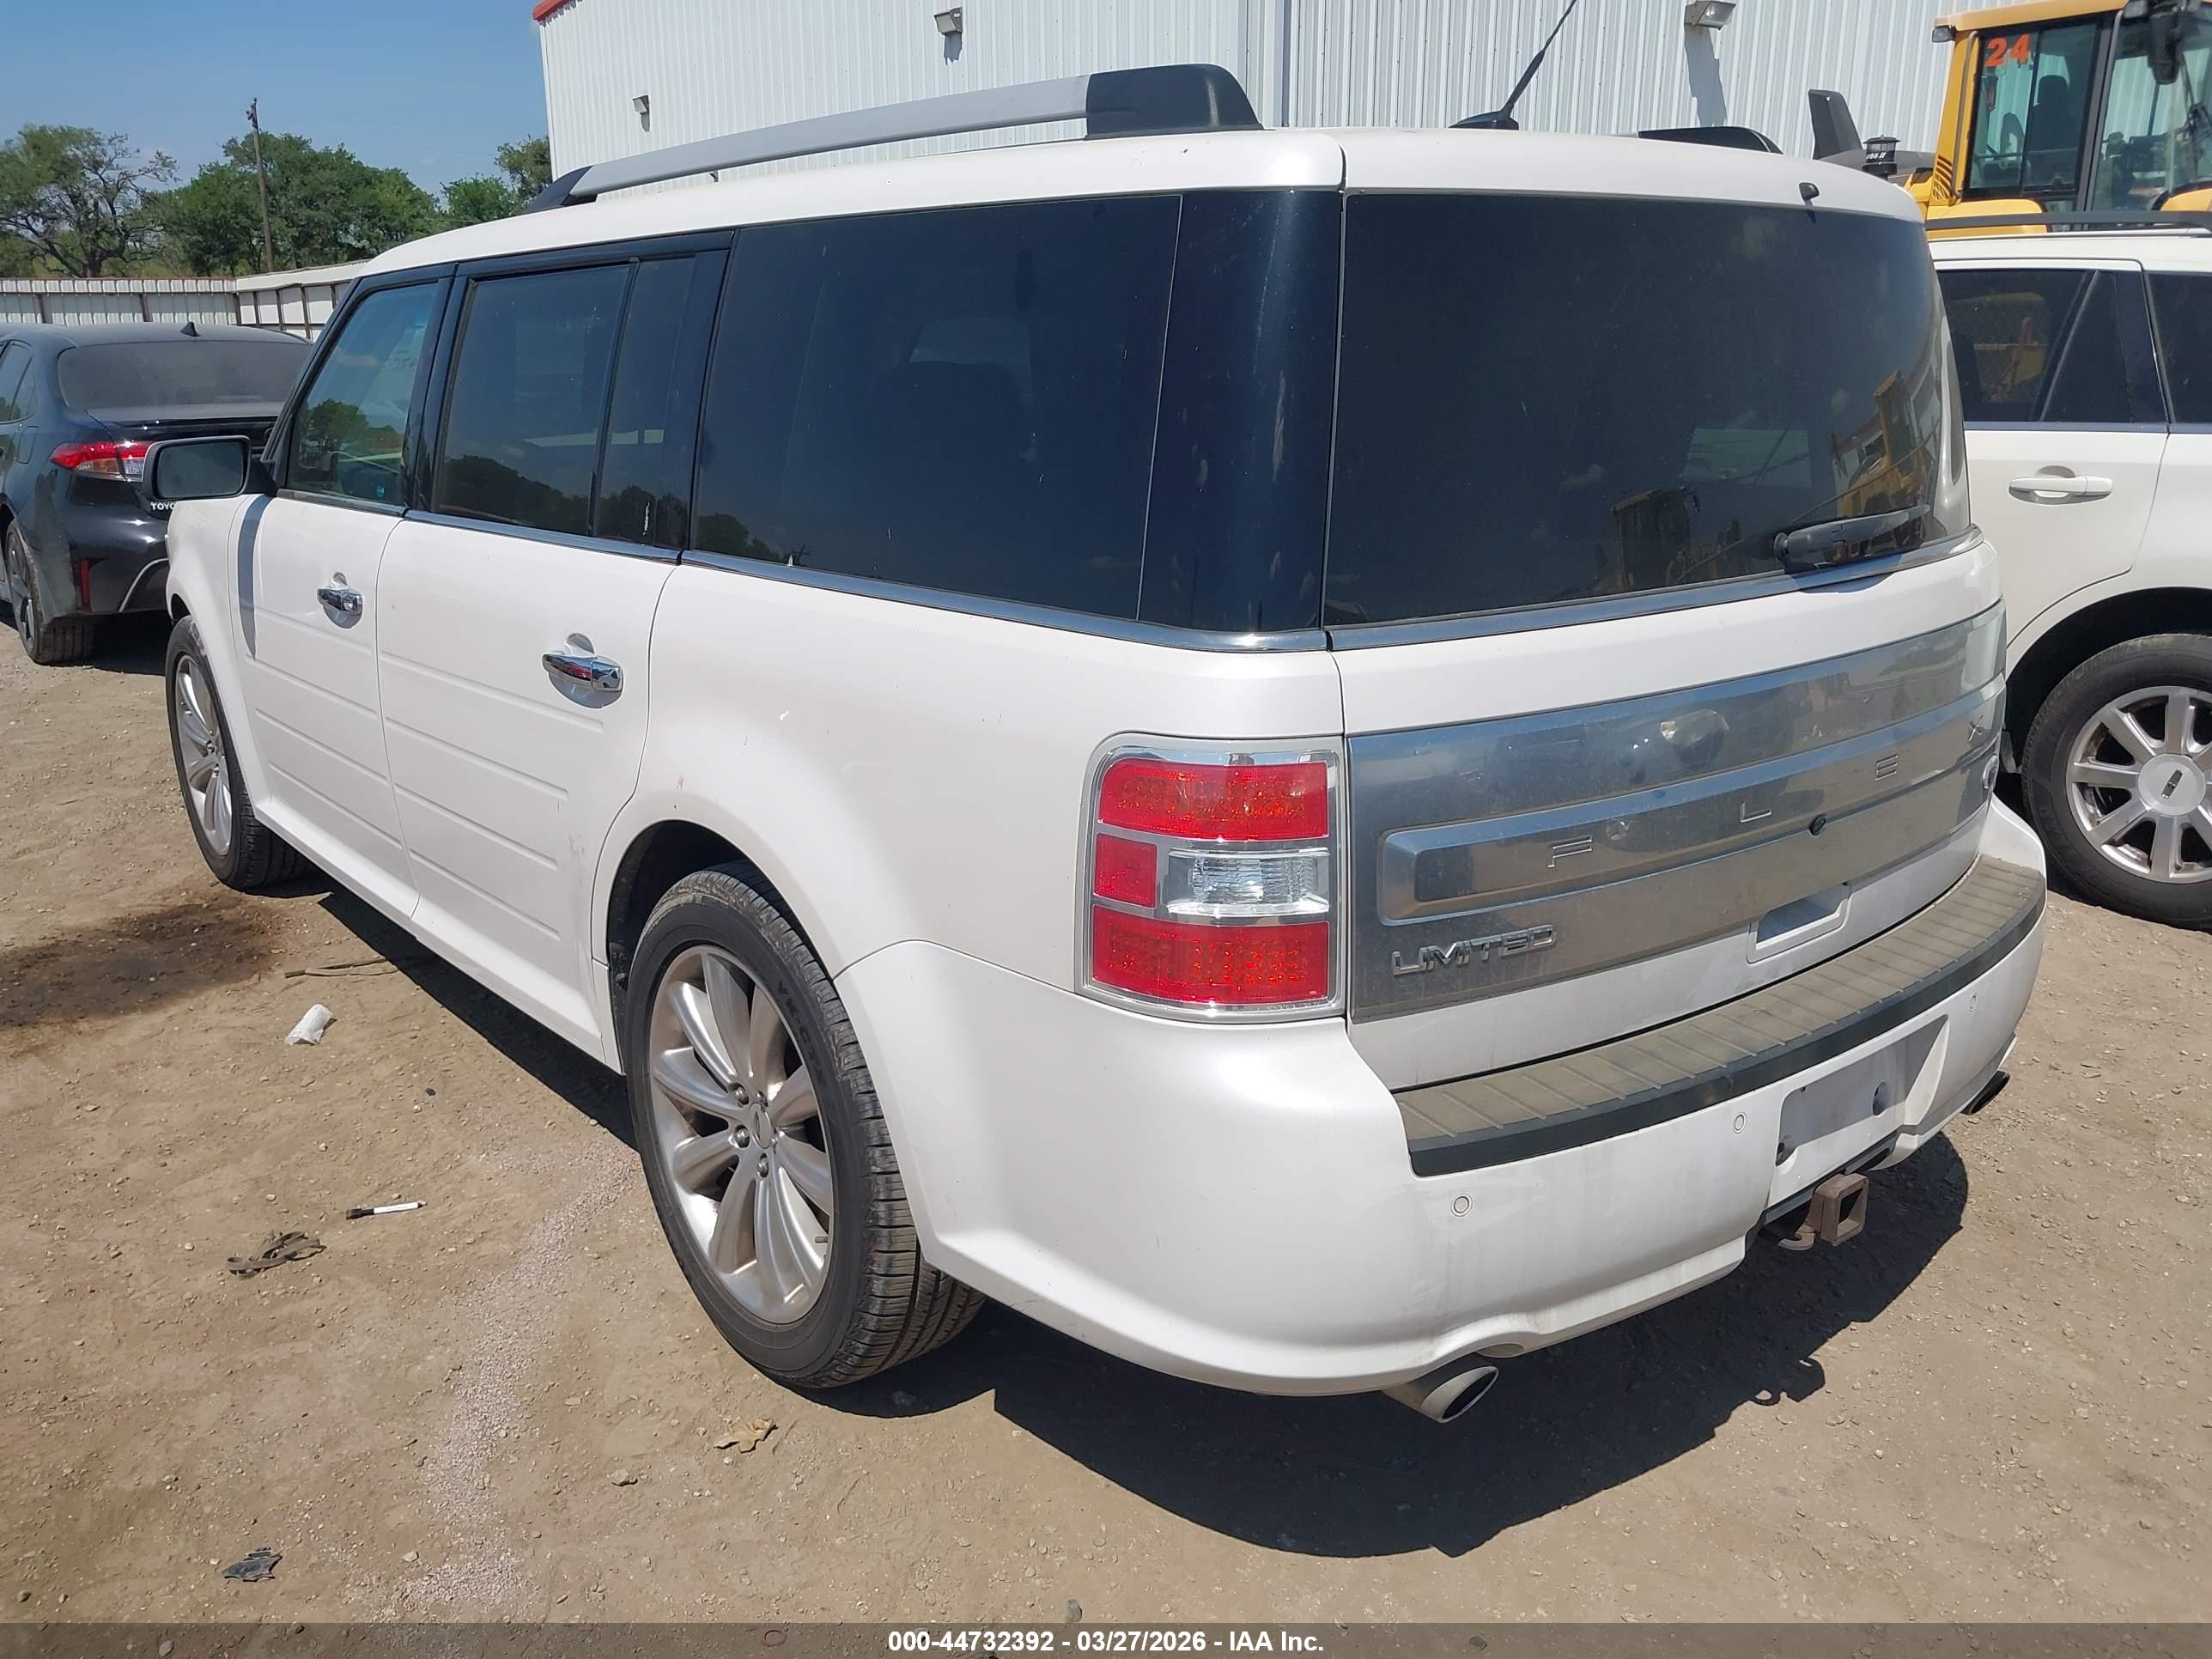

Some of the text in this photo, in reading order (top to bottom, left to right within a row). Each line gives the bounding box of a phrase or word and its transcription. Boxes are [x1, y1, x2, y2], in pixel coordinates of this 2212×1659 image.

[1984, 33, 2030, 67] 24
[150, 501, 176, 511] TOYO
[1391, 924, 1557, 976] LIMITED
